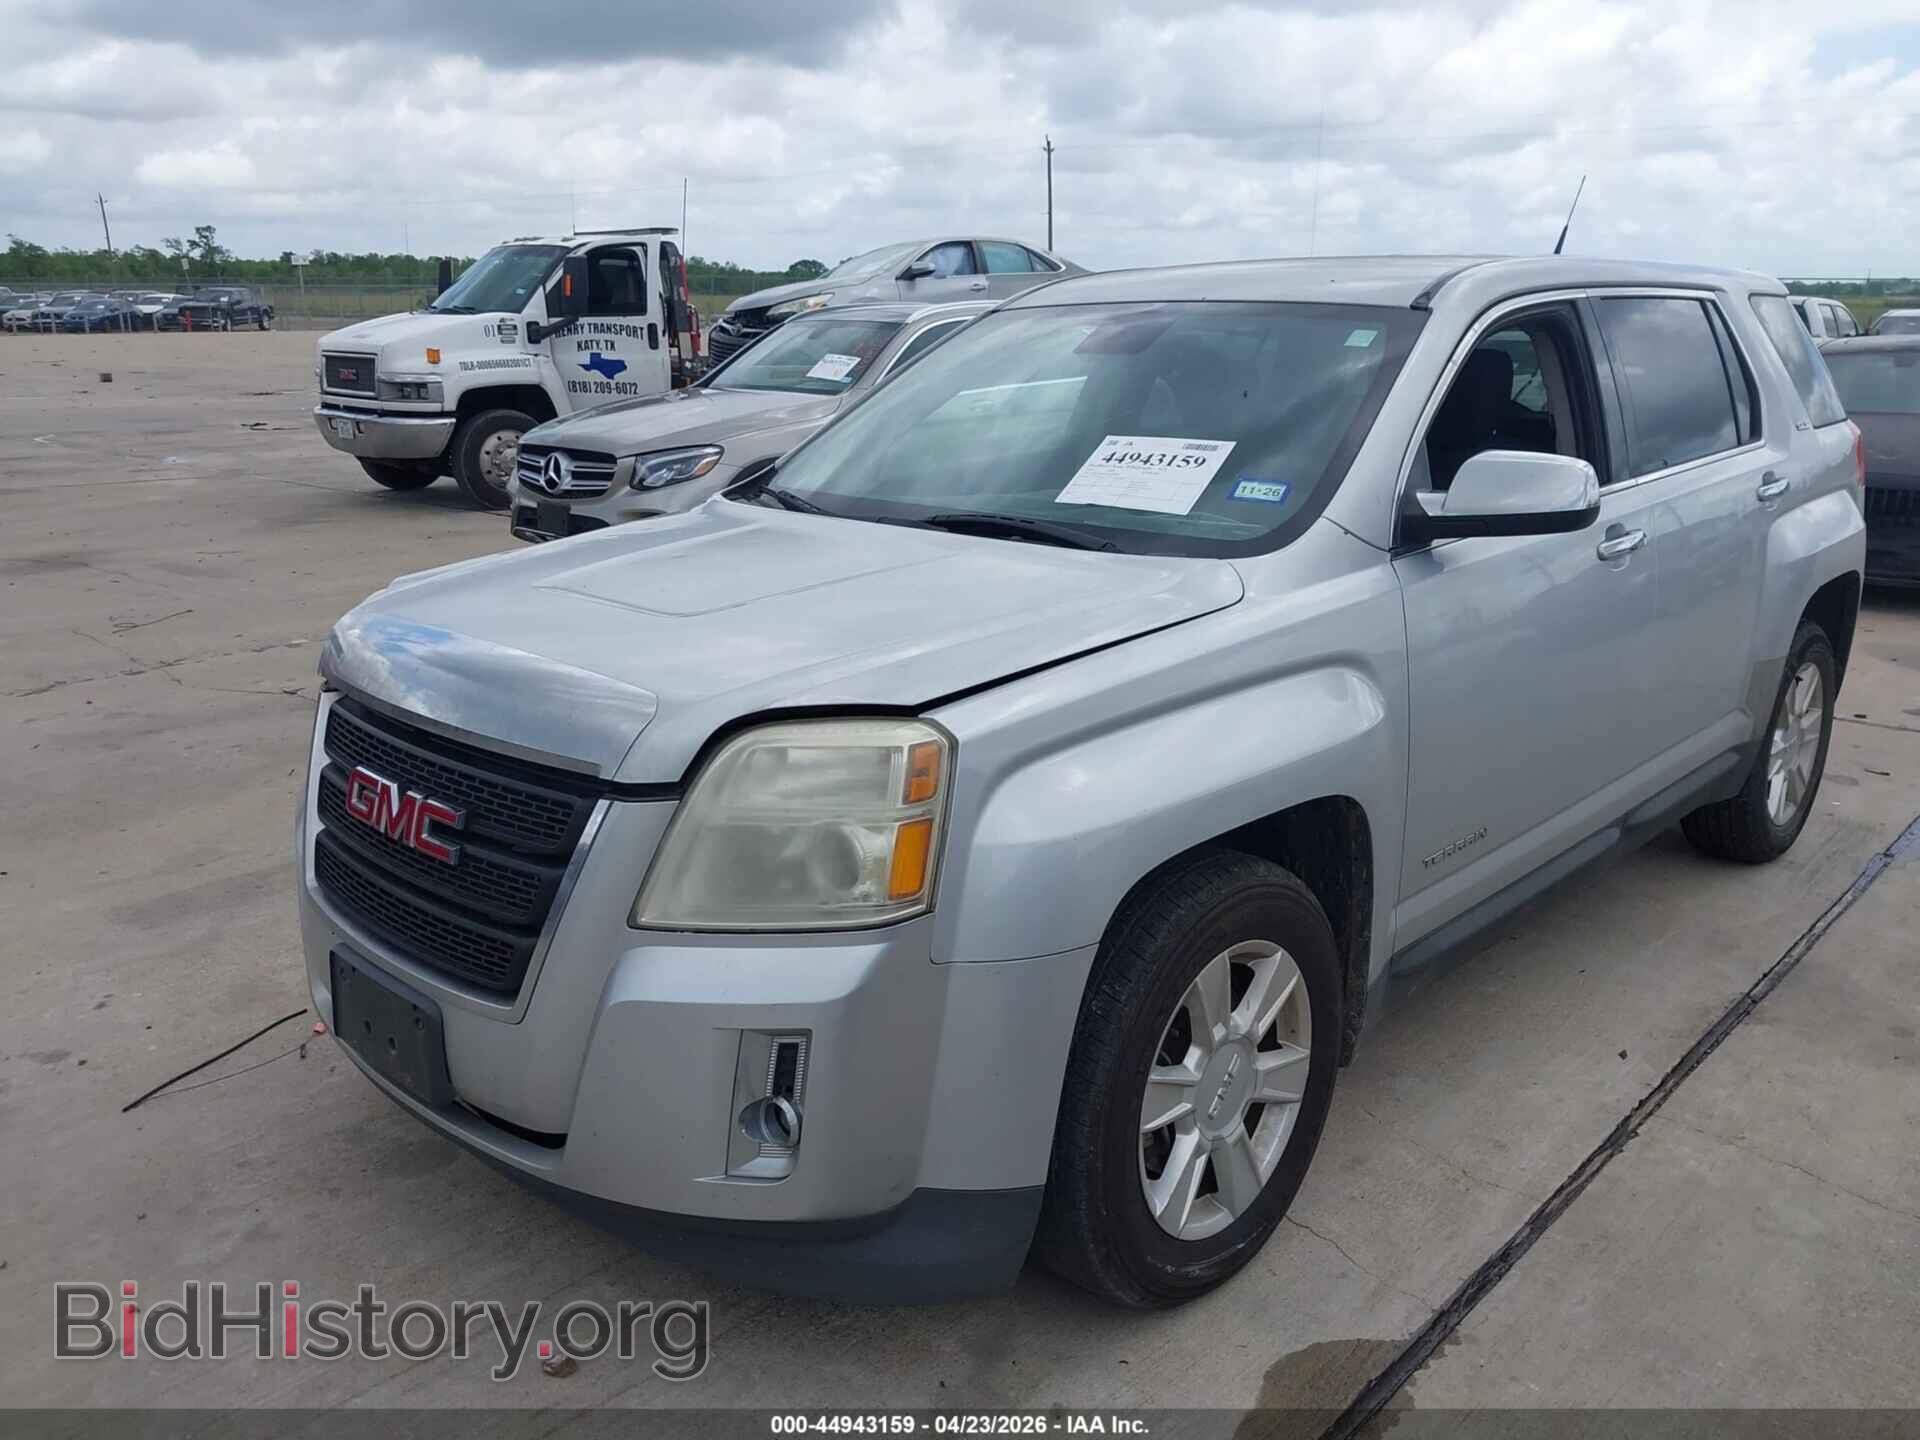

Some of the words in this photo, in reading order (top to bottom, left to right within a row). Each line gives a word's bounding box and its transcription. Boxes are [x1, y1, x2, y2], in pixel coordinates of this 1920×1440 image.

[587, 322, 645, 340] TRANSPORT
[577, 339, 603, 352] KATY,
[604, 339, 617, 352] TX
[567, 380, 592, 393] (818)
[594, 381, 639, 395] 209-6072
[1102, 452, 1207, 469] 44943159
[344, 765, 466, 865] GMC
